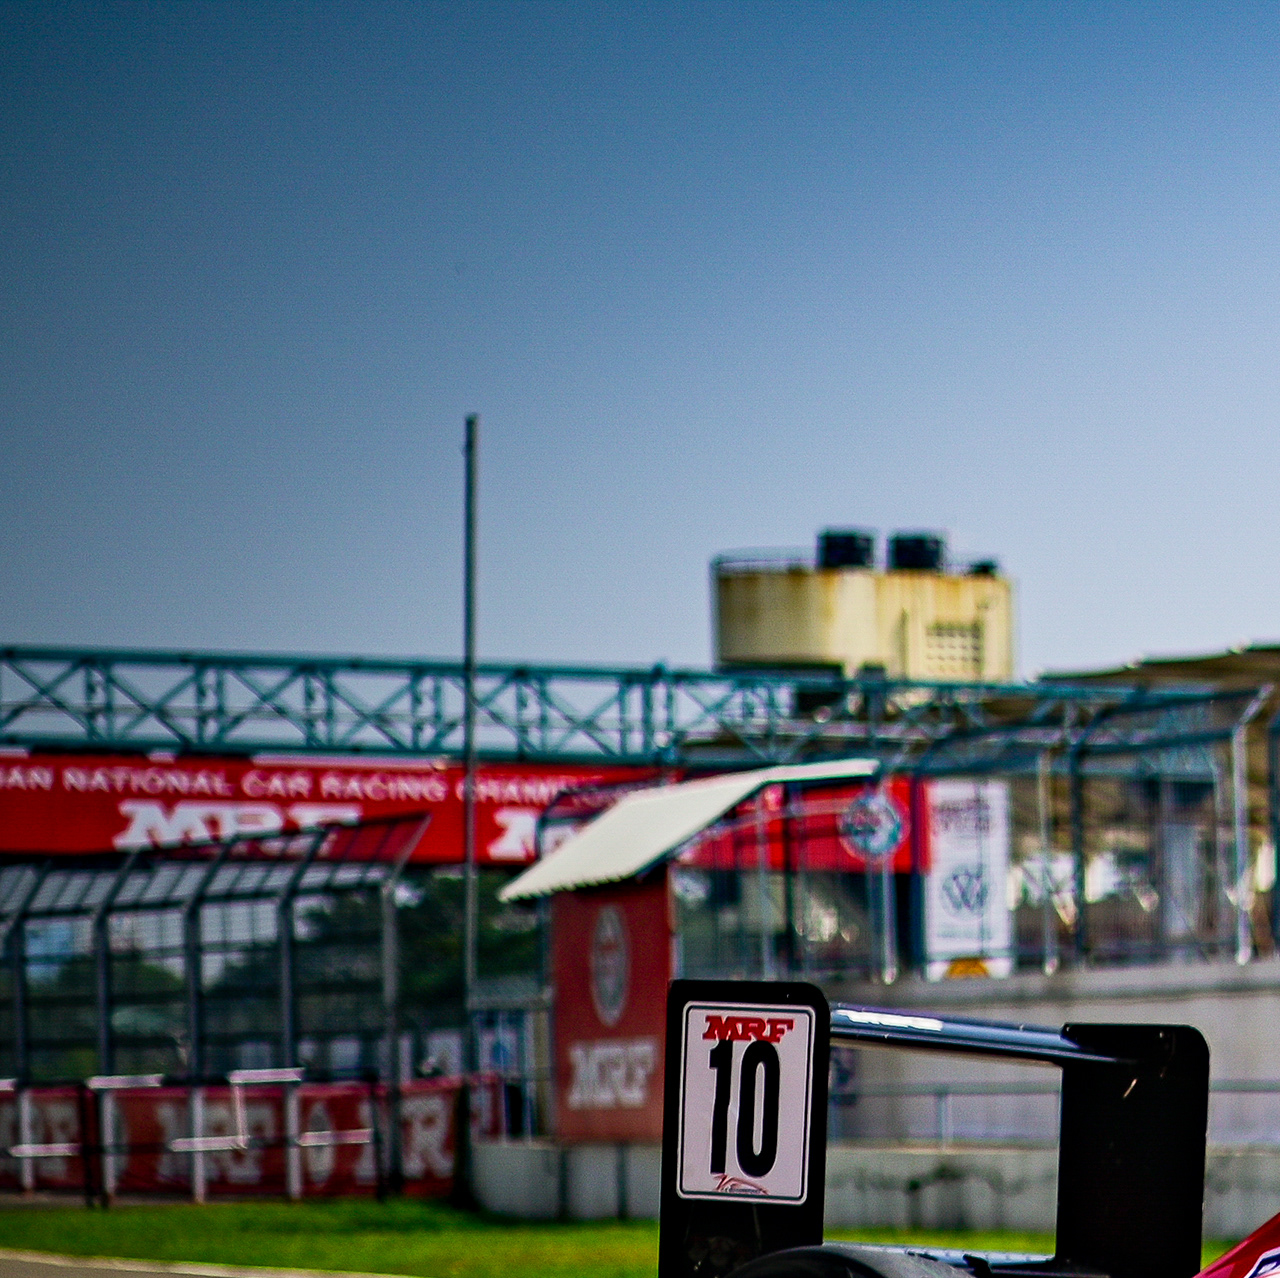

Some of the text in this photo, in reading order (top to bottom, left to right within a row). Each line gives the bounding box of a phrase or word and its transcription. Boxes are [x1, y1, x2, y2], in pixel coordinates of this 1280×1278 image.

[62, 766, 234, 797] NATIONAL
[241, 768, 313, 799] CAR
[321, 772, 447, 802] RACING
[702, 1016, 794, 1043] MRF
[569, 1037, 656, 1108] MRF
[709, 1039, 780, 1178] 10
